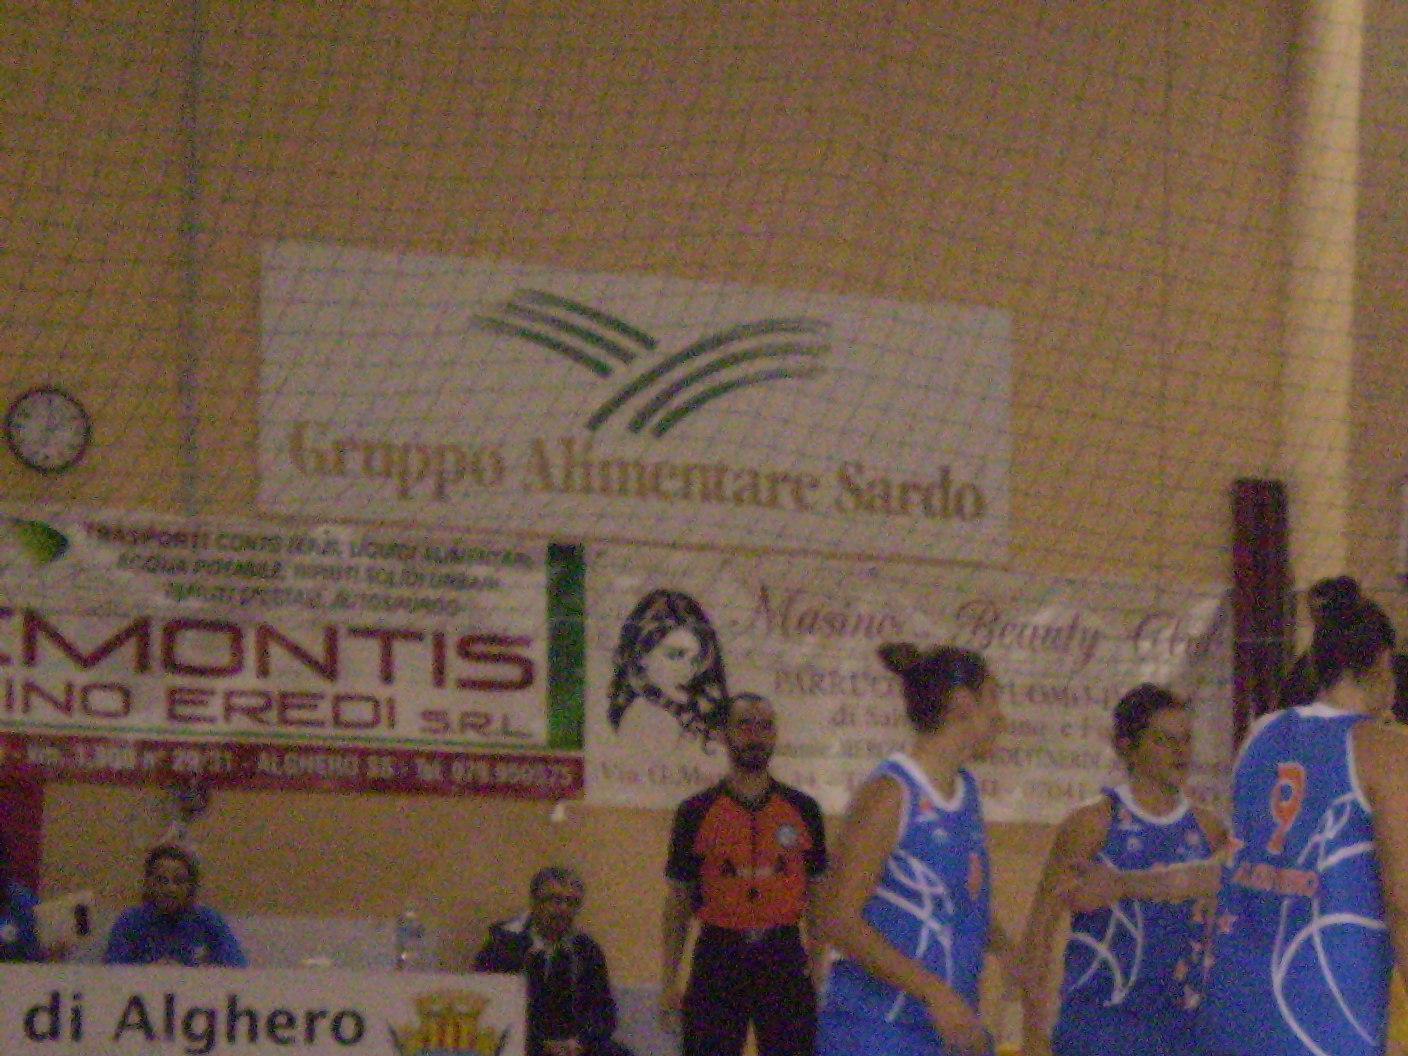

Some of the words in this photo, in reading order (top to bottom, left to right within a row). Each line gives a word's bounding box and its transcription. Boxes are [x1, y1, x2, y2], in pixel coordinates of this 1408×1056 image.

[287, 420, 505, 501] Gruppo
[522, 434, 821, 511] Alimentare
[834, 460, 988, 522] Sardo
[0, 606, 535, 692] MONTIS
[166, 685, 397, 731] EREDI
[1267, 761, 1307, 856] 9
[22, 989, 84, 1042] di
[113, 992, 367, 1056] Alghero
